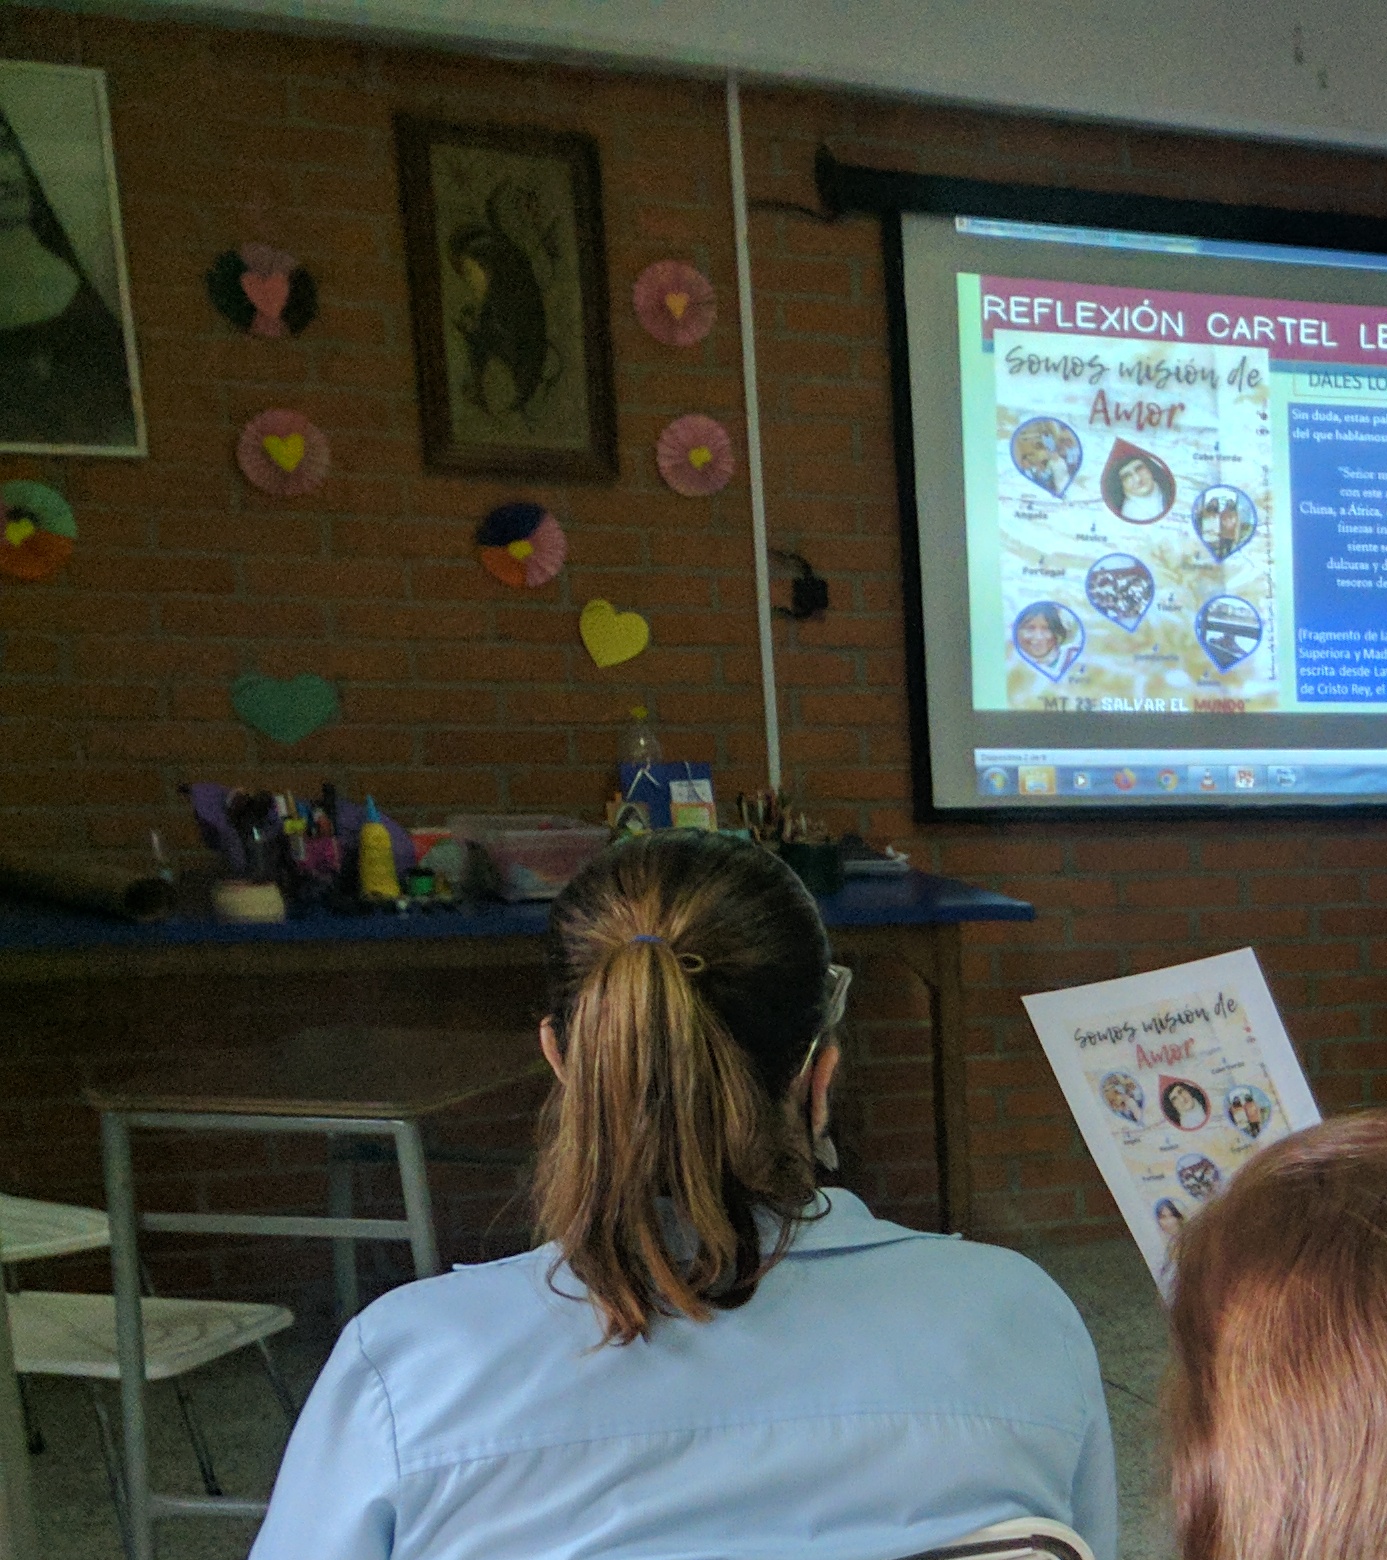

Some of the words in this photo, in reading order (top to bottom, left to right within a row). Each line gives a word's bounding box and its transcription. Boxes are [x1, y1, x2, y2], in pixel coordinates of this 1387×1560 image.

[983, 294, 1184, 337] REFLEXIÓN
[1206, 311, 1338, 347] CARTEL
[1005, 345, 1110, 385] Somos
[1118, 357, 1220, 390] misión
[1227, 356, 1263, 392] de
[1309, 371, 1362, 390] DALES
[1088, 389, 1186, 431] Amor
[1292, 410, 1308, 420] Sin
[1312, 410, 1342, 423] duda,
[1344, 414, 1370, 423] estas
[1292, 428, 1310, 439] del
[1313, 431, 1332, 442] que
[1340, 488, 1360, 497] con
[1363, 488, 1382, 498] este
[1348, 542, 1378, 553] siente
[1337, 578, 1373, 588] tesoros
[1364, 630, 1378, 641] de
[1300, 648, 1350, 661] Superiora
[1300, 666, 1335, 677] escrita
[1339, 666, 1370, 677] desde
[1301, 683, 1314, 694] de
[1317, 683, 1348, 695] Cristo
[1351, 684, 1373, 697] Rey,
[1376, 684, 1385, 695] el
[1101, 697, 1166, 713] SALVAR
[1170, 698, 1189, 713] EL
[1073, 1021, 1137, 1049] Somos
[1141, 1003, 1210, 1035] misión
[1213, 991, 1238, 1019] de
[1135, 1037, 1195, 1070] Amor
